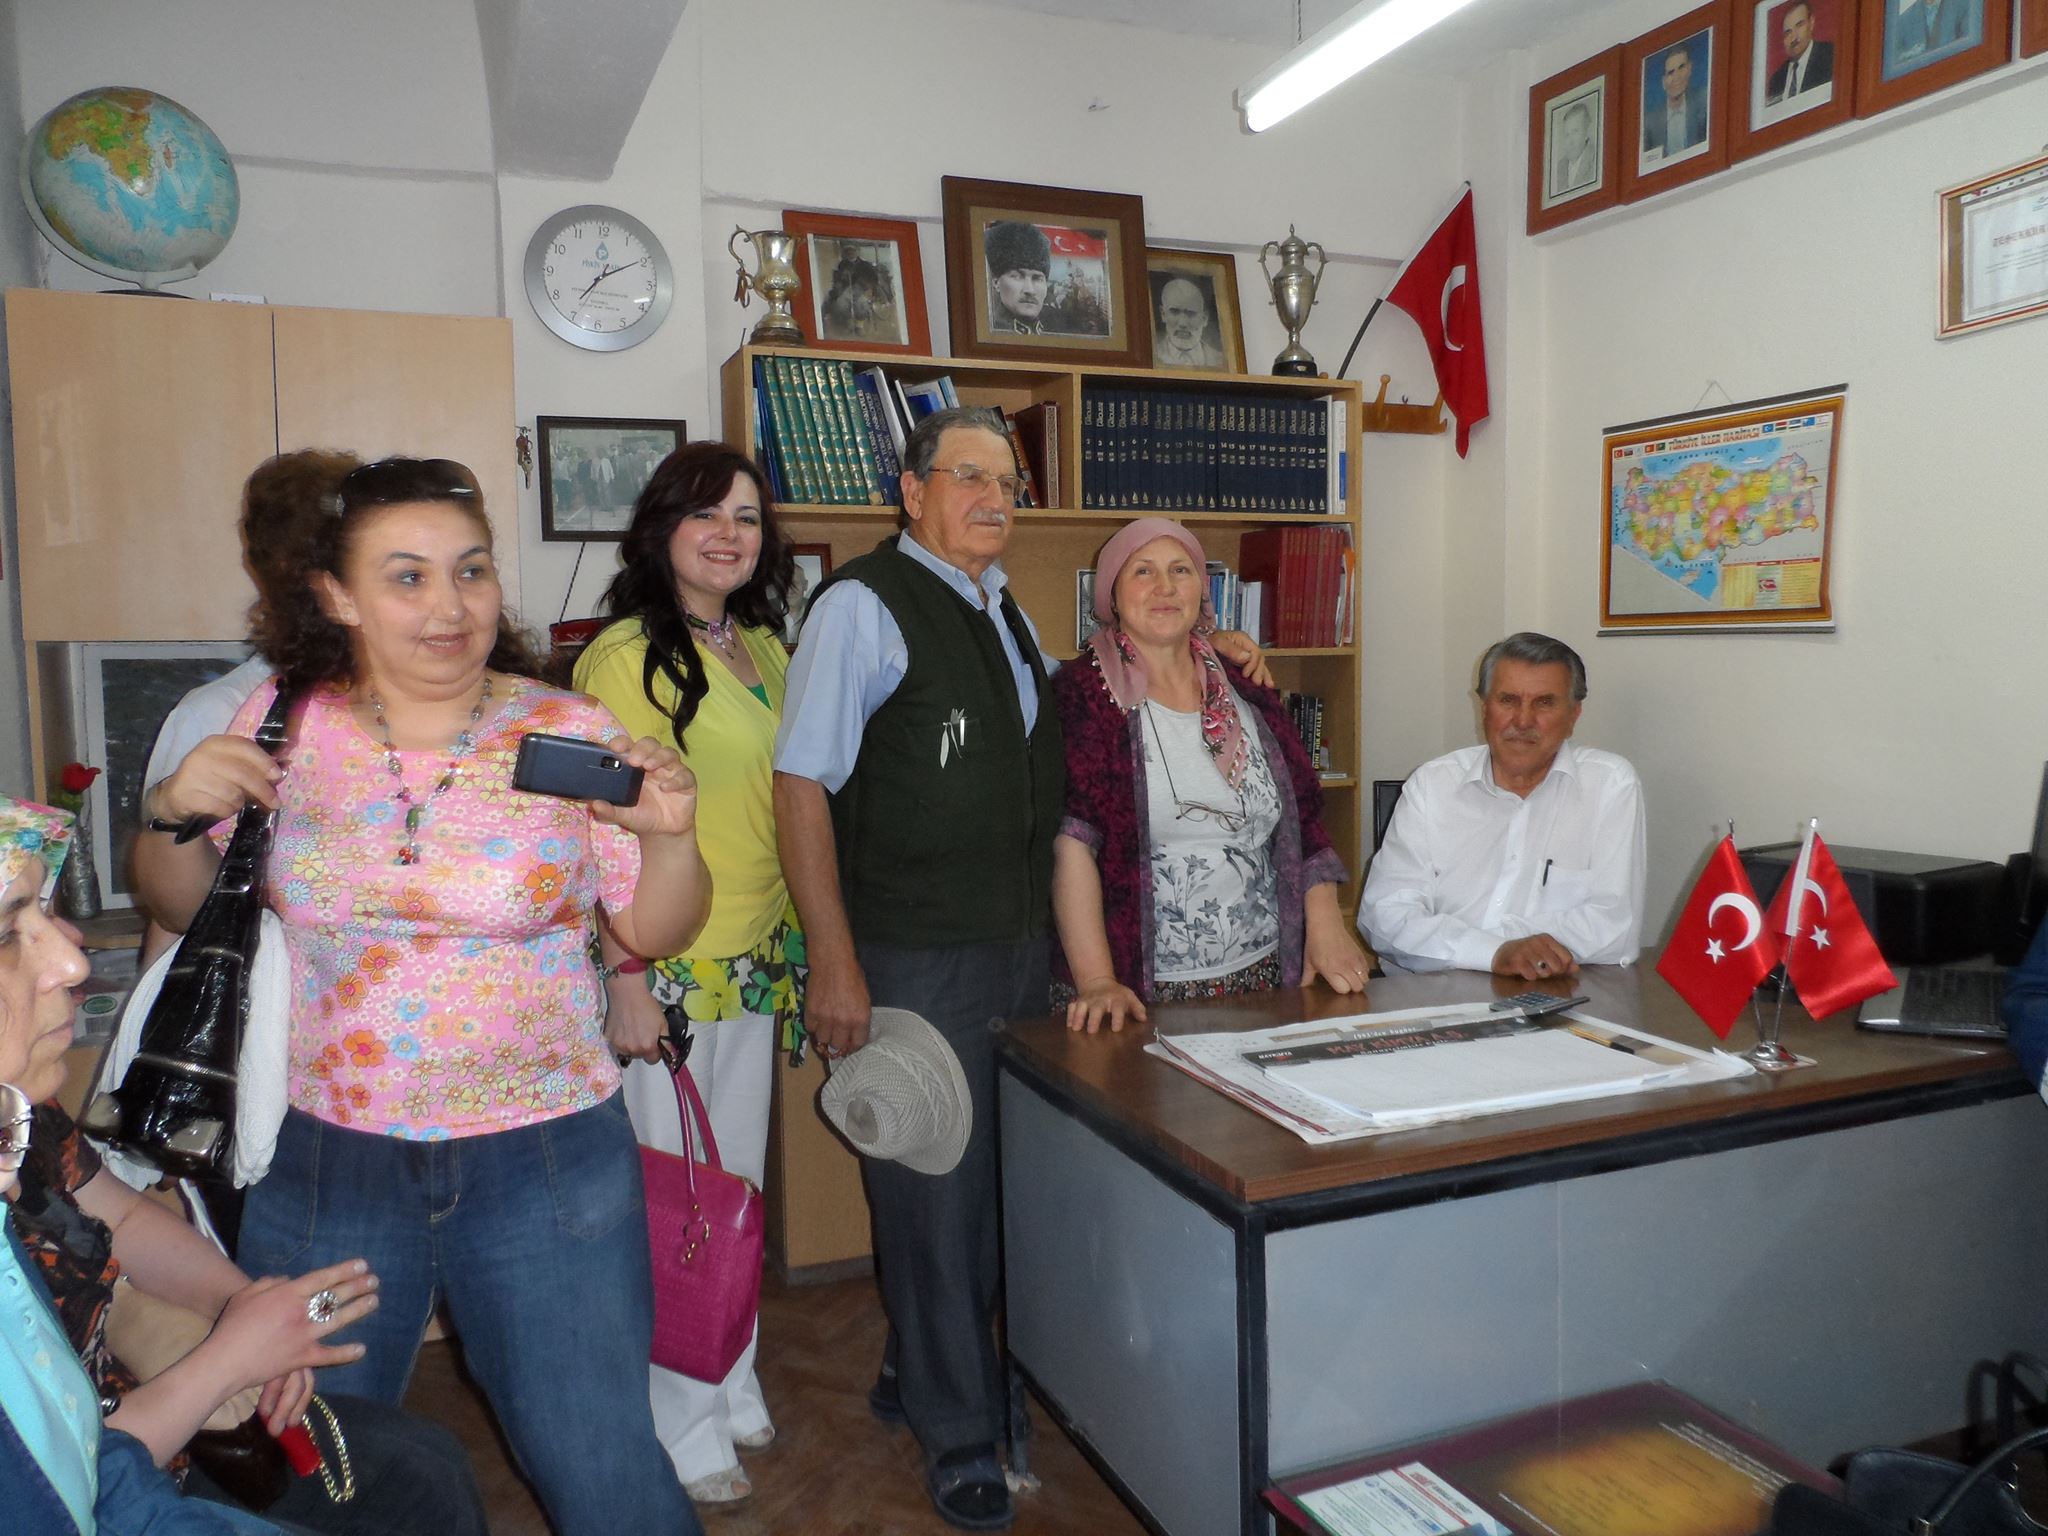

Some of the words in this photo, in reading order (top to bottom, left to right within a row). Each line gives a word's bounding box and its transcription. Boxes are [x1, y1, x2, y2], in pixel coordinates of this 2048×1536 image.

[574, 229, 582, 239] 11
[599, 227, 610, 237] 12
[554, 245, 565, 254] 10
[640, 257, 647, 267] 2
[547, 266, 554, 276] 9
[646, 281, 652, 291] 3
[553, 289, 560, 300] 8
[571, 311, 577, 321] 7
[594, 320, 602, 330] 6
[619, 317, 626, 327] 5
